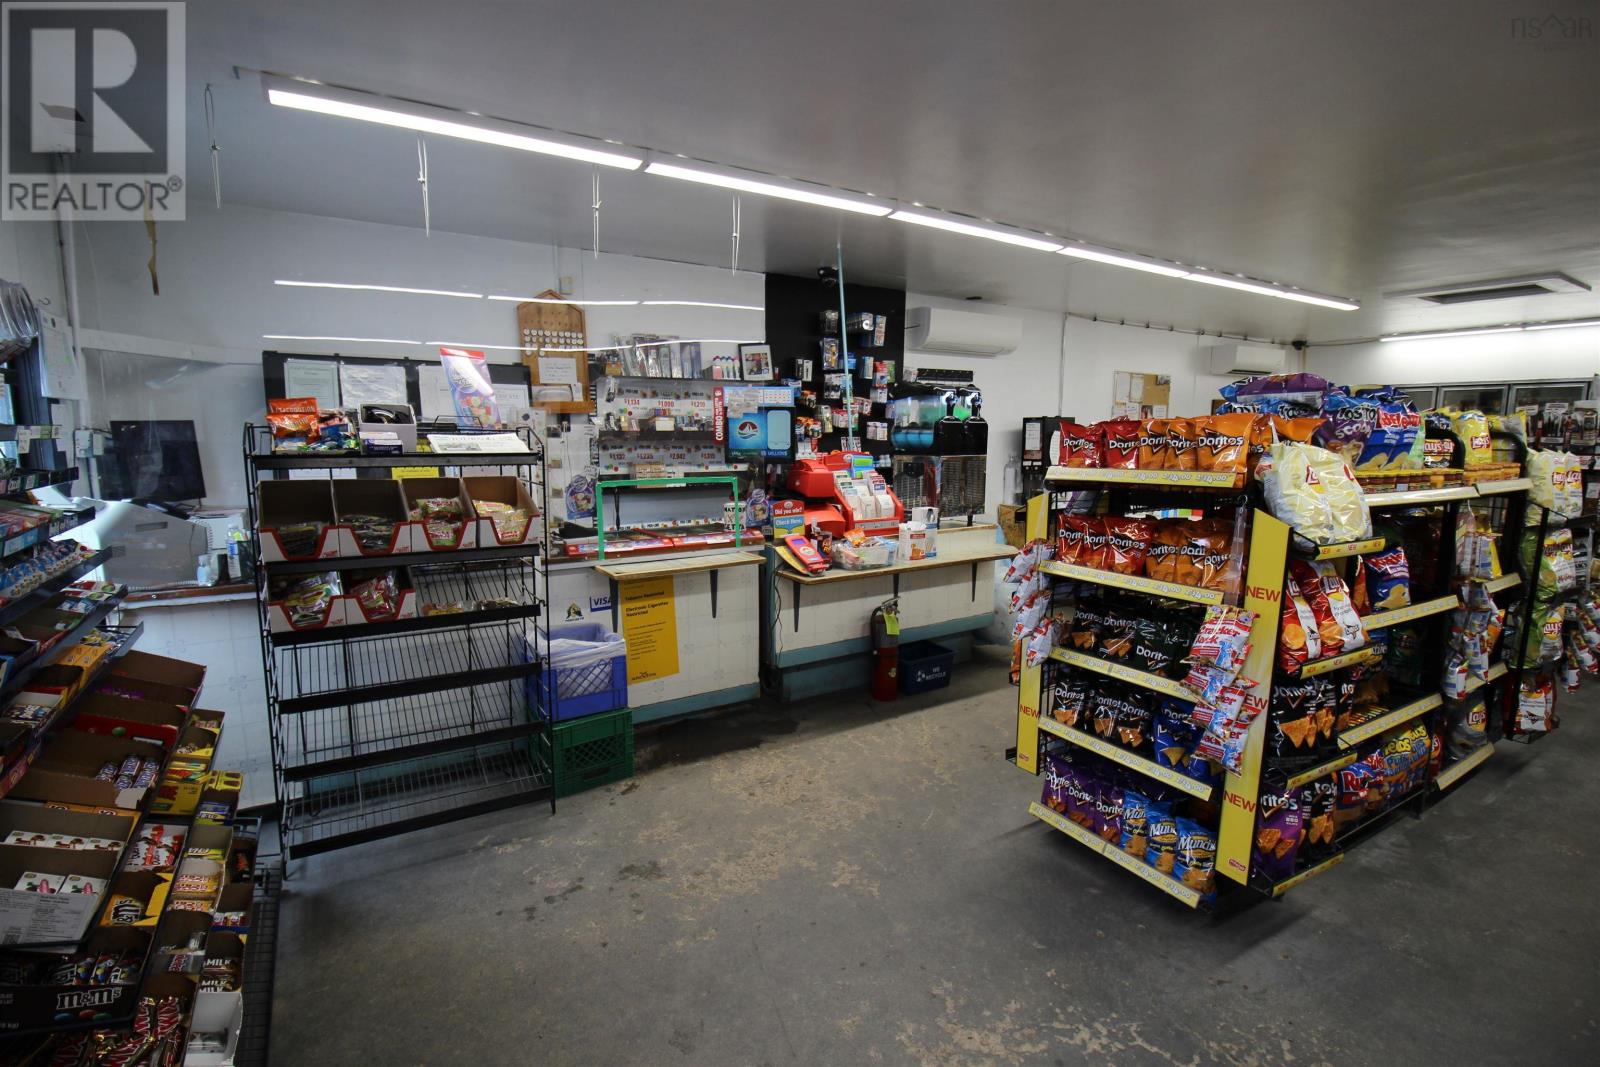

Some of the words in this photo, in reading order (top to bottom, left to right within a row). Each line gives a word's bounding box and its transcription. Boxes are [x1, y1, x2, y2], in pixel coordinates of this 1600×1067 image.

[1063, 438, 1096, 450] Doritos
[1109, 440, 1140, 449] Dorito
[1198, 436, 1244, 447] Doritos
[1108, 536, 1146, 549] Doritos
[1247, 586, 1281, 601] NEW
[1136, 645, 1170, 662] Dorito
[1245, 694, 1268, 710] EW
[1020, 703, 1040, 718] NEW
[1068, 785, 1094, 803] Dorito
[1223, 790, 1256, 813] NEW
[1096, 801, 1124, 816] Dorito
[1261, 794, 1298, 811] ritos
[206, 958, 232, 967] MILK
